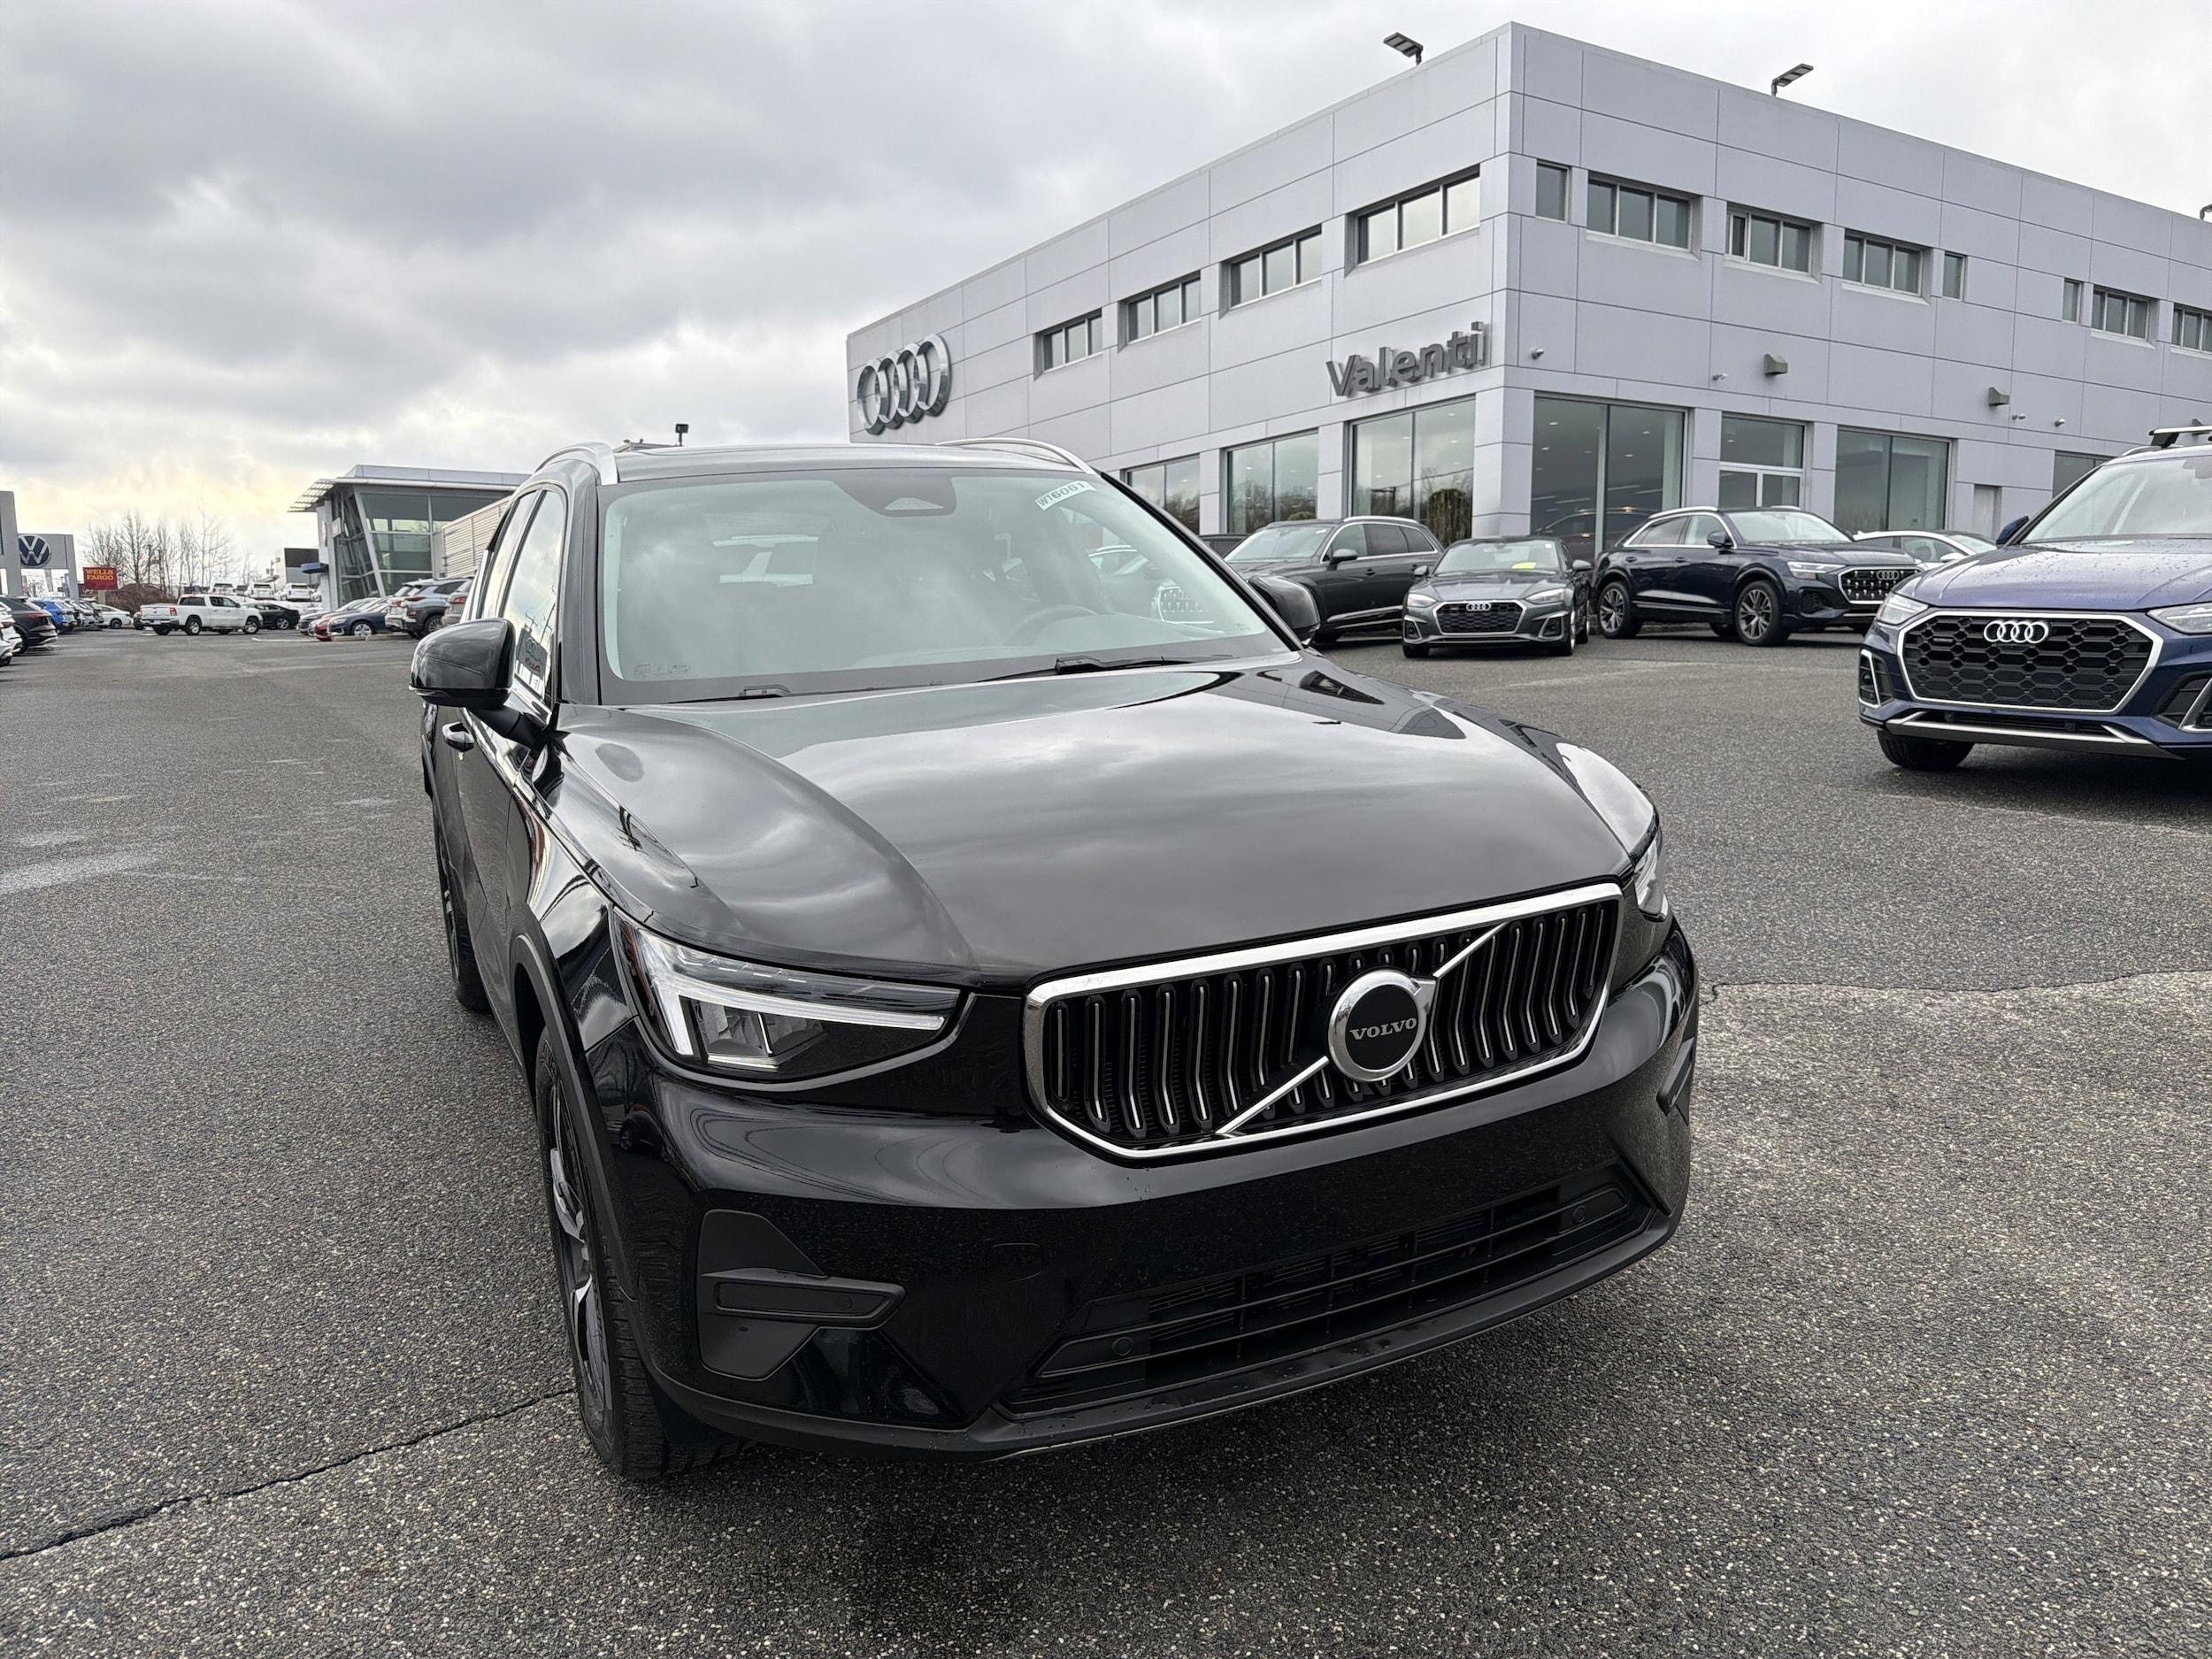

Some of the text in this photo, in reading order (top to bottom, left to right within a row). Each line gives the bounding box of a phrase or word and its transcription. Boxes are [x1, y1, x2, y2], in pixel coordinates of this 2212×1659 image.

[1325, 321, 1484, 396] Valenti
[1037, 482, 1085, 506] W16061
[1349, 1018, 1417, 1041] VOLVO
